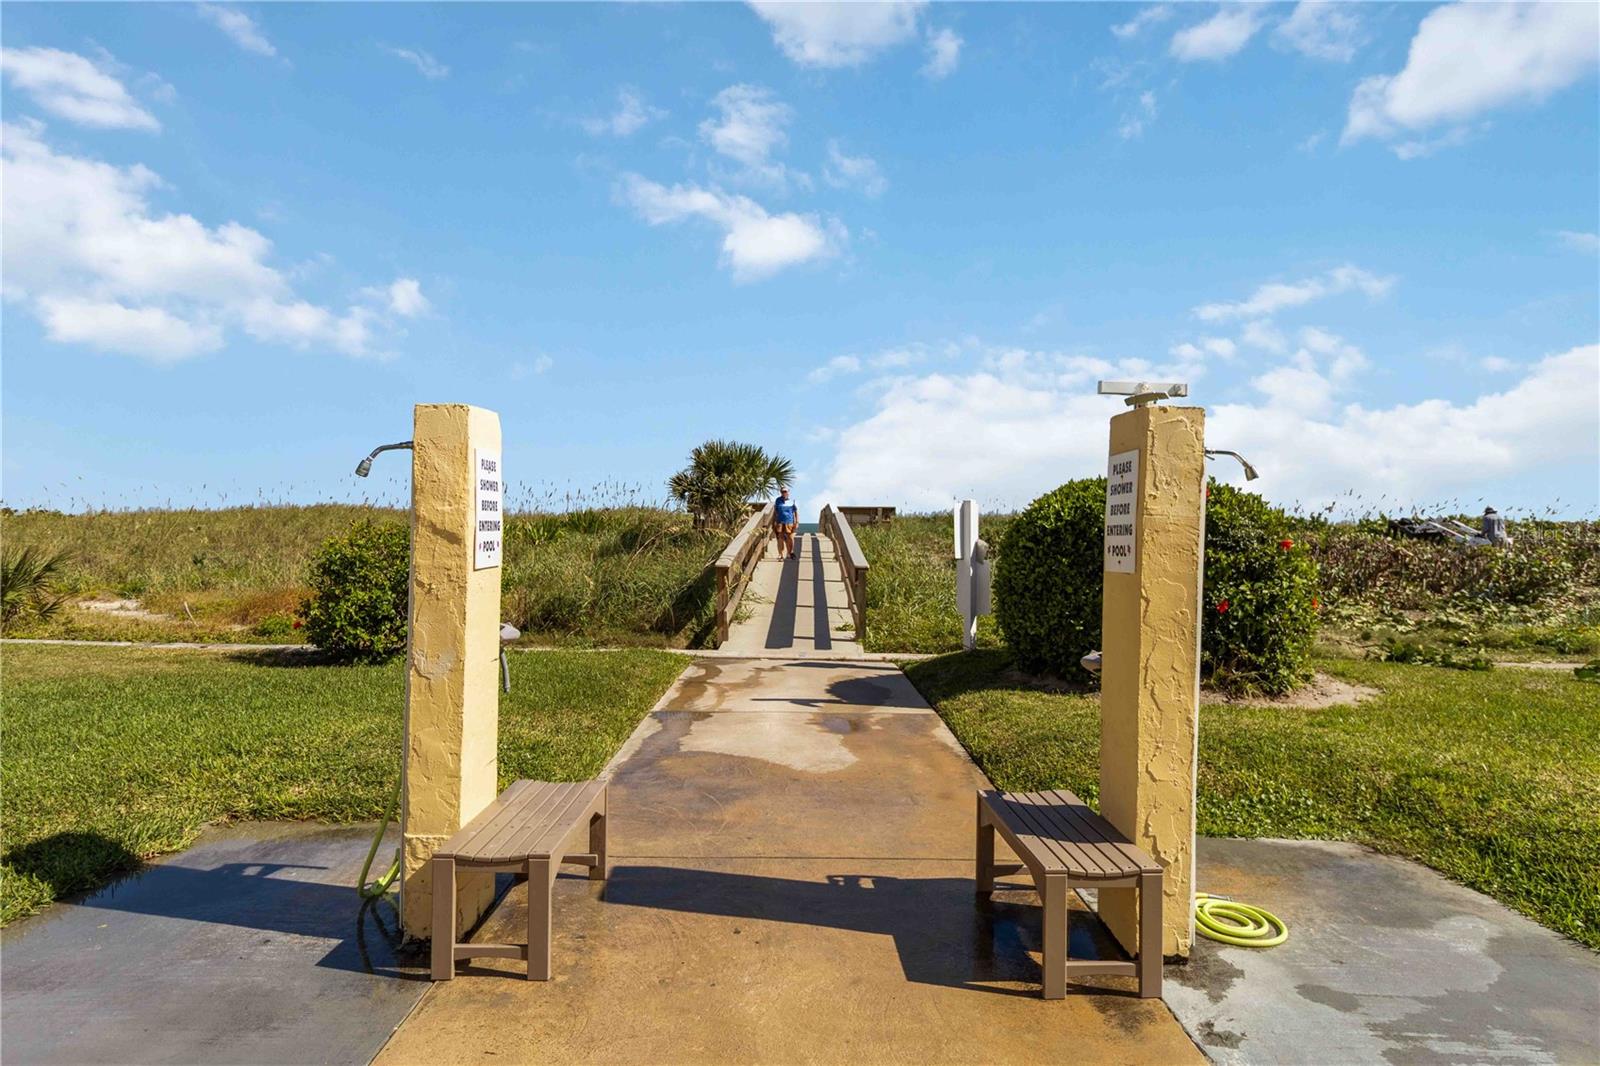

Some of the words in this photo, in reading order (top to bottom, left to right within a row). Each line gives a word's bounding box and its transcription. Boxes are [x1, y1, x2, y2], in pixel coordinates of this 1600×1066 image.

[481, 459, 497, 473] PLEASE
[1113, 461, 1132, 476] PLEASE
[480, 479, 498, 492] SHOWER
[1110, 482, 1133, 496] SHOWER
[481, 500, 498, 512] BEFORE
[1110, 503, 1130, 516] BEFORE
[479, 521, 500, 532] ENTERING
[1107, 524, 1133, 536] ENTERING
[483, 541, 495, 552] POOL
[1112, 545, 1127, 557] POOL
